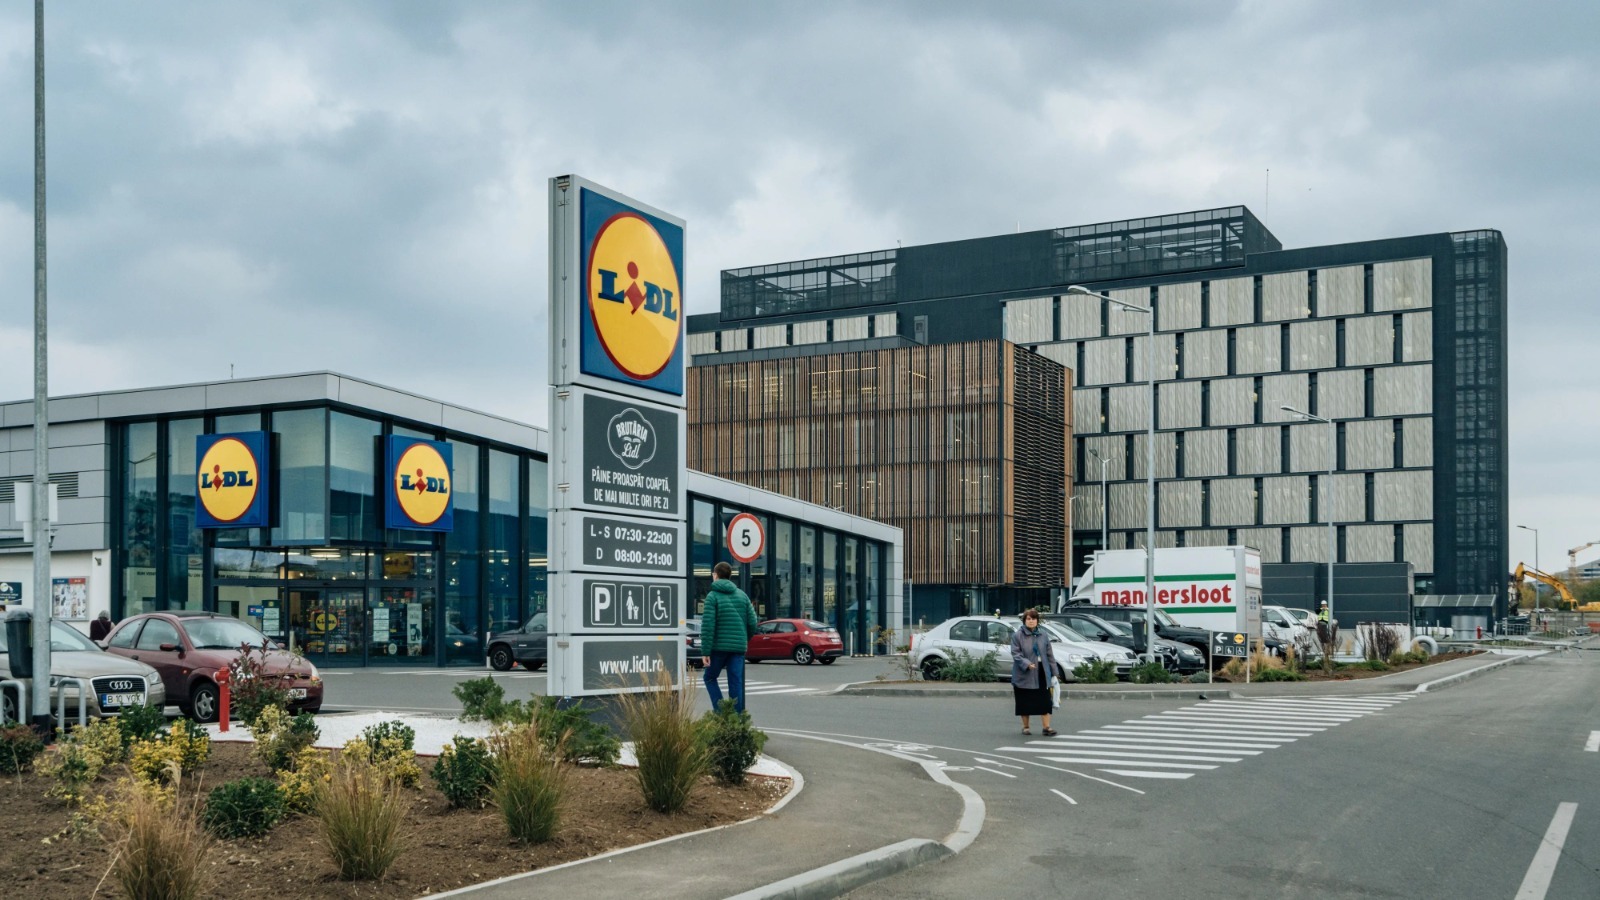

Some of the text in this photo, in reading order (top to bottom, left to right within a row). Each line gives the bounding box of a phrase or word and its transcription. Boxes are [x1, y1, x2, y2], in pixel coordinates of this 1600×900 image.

[616, 420, 648, 443] BRUTĂRIA
[621, 442, 641, 459] Lidl
[591, 466, 671, 494] PÂINE PROASPĂT COAPTĂ,
[594, 488, 669, 510] DE MAI MULTE ORI PE ZI
[590, 524, 597, 537] L
[604, 525, 611, 539] S
[741, 529, 751, 548] 5
[596, 547, 603, 560] D
[594, 586, 611, 622] P
